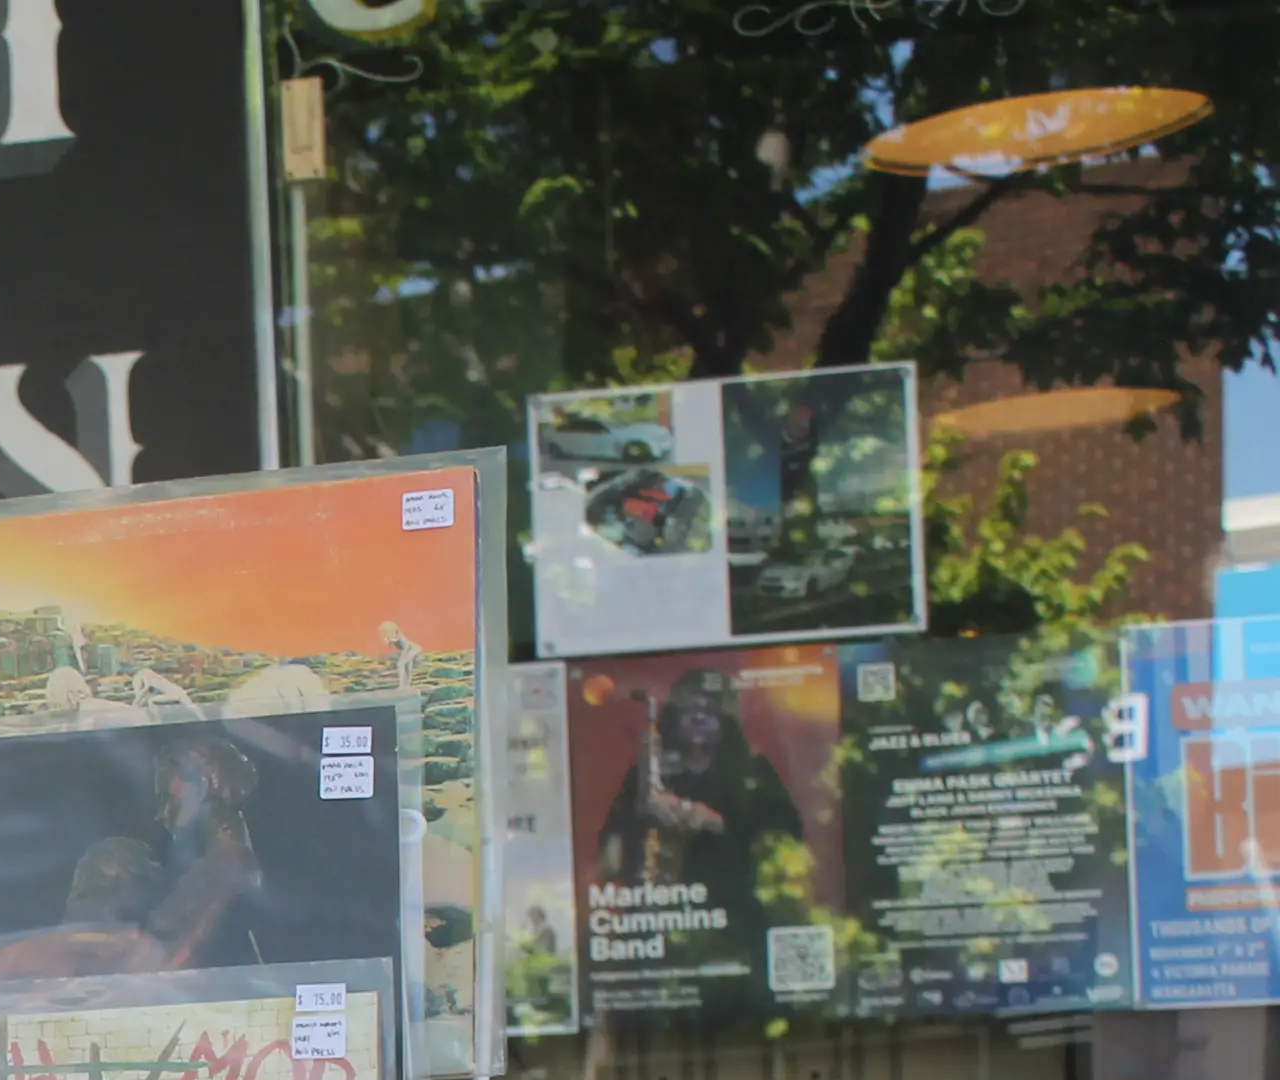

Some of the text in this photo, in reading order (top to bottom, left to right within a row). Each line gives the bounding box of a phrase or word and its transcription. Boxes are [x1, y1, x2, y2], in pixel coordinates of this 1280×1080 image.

[340, 735, 368, 749] 35.00
[589, 880, 708, 908] Marlene
[590, 906, 728, 935] Cummins
[590, 933, 666, 962] Band
[313, 992, 342, 1006] 75.00
